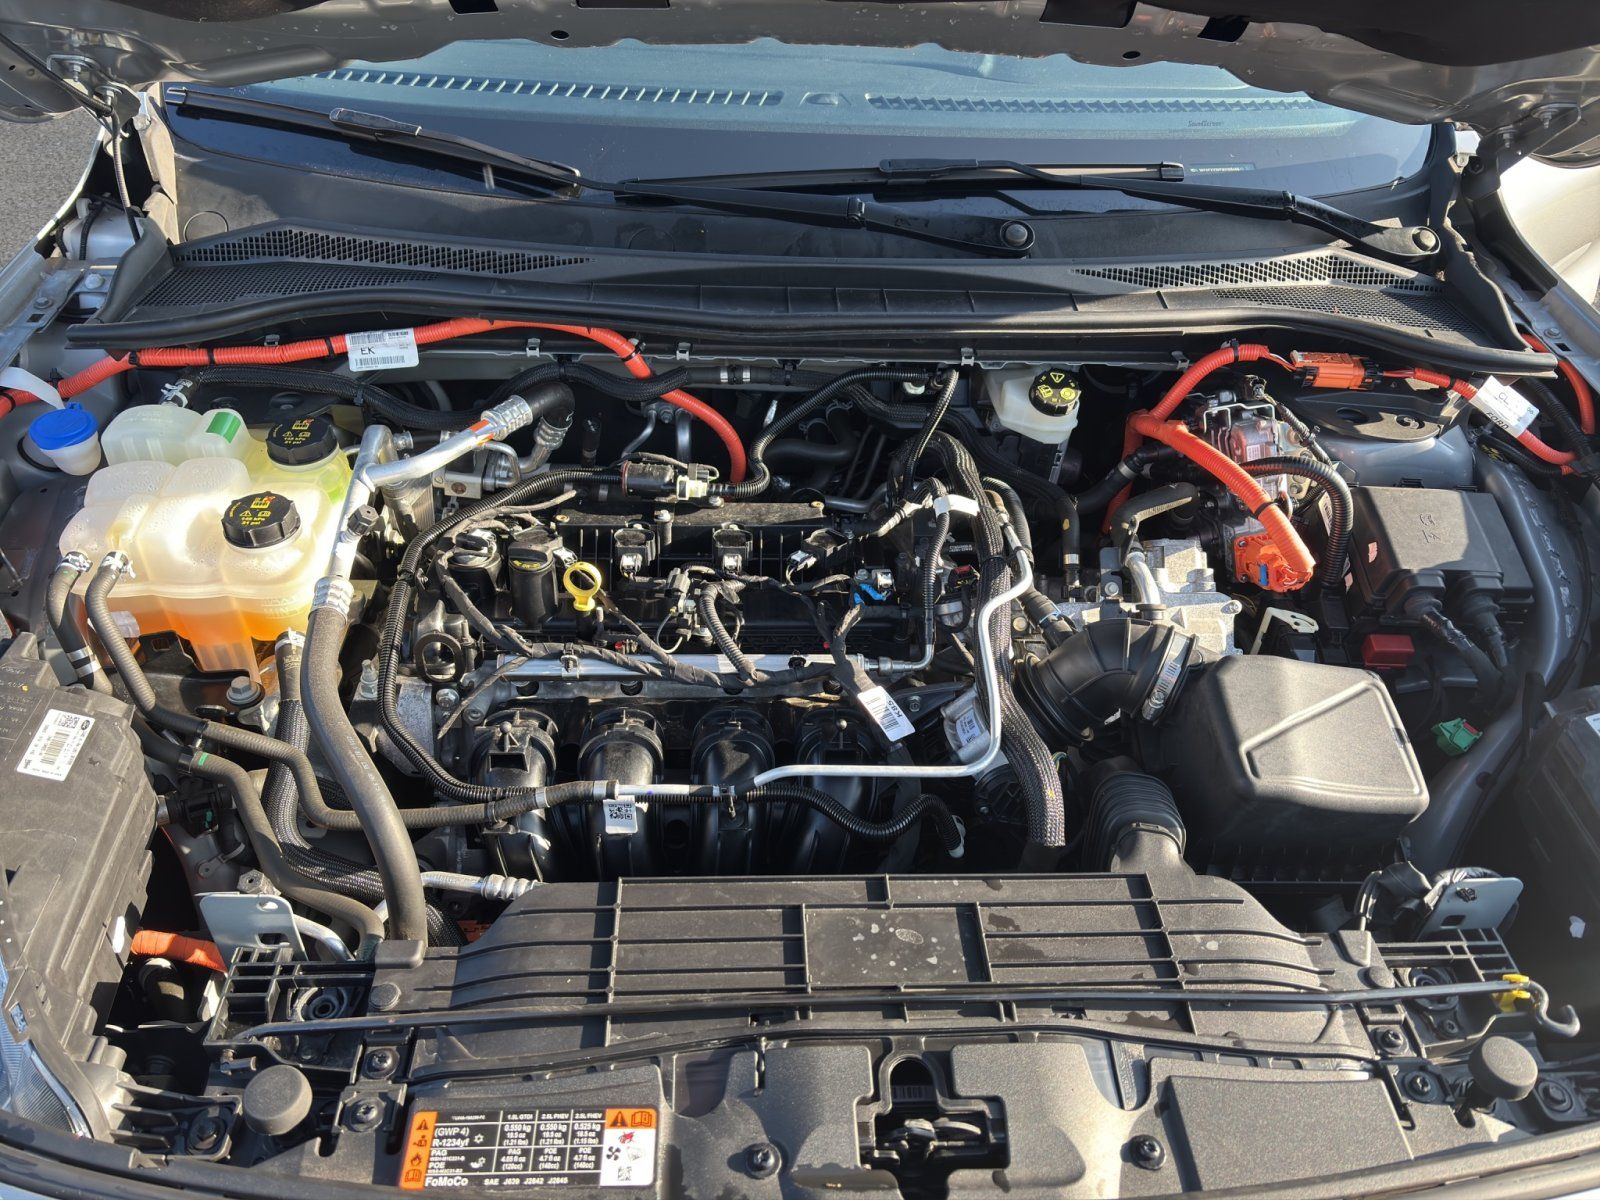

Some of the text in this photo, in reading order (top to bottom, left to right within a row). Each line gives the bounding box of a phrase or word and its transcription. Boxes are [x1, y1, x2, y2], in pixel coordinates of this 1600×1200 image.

[361, 347, 375, 355] EK
[523, 1124, 531, 1132] kg
[559, 1124, 567, 1132] kg
[592, 1123, 601, 1131] kg
[435, 1127, 470, 1137] (GWP 4)
[432, 1138, 470, 1147] R-1234yf
[425, 1176, 468, 1186] FoMoCo
